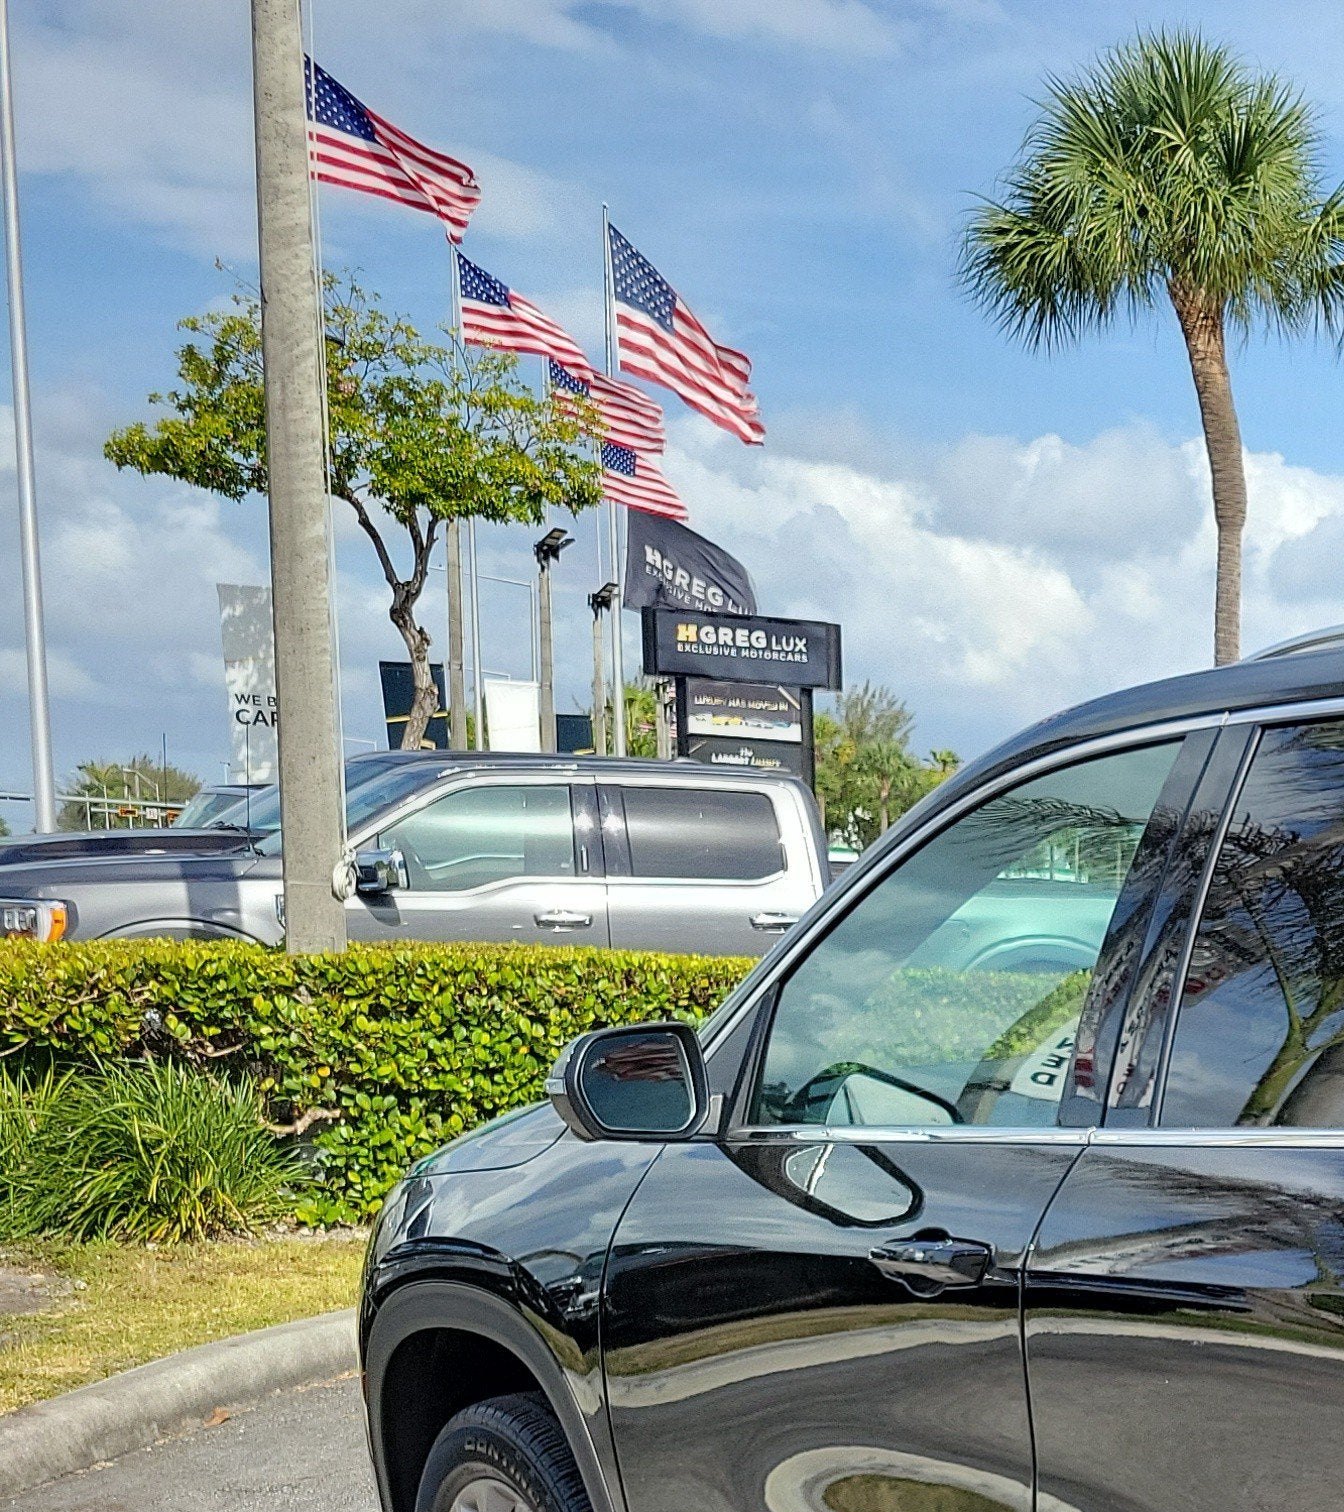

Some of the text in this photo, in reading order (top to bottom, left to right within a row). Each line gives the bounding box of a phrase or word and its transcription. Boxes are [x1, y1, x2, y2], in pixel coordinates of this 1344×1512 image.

[727, 598, 753, 615] LU
[771, 635, 808, 653] LUX
[677, 643, 808, 664] EXCLUSIVE MOTORCARS
[234, 693, 278, 707] WE B
